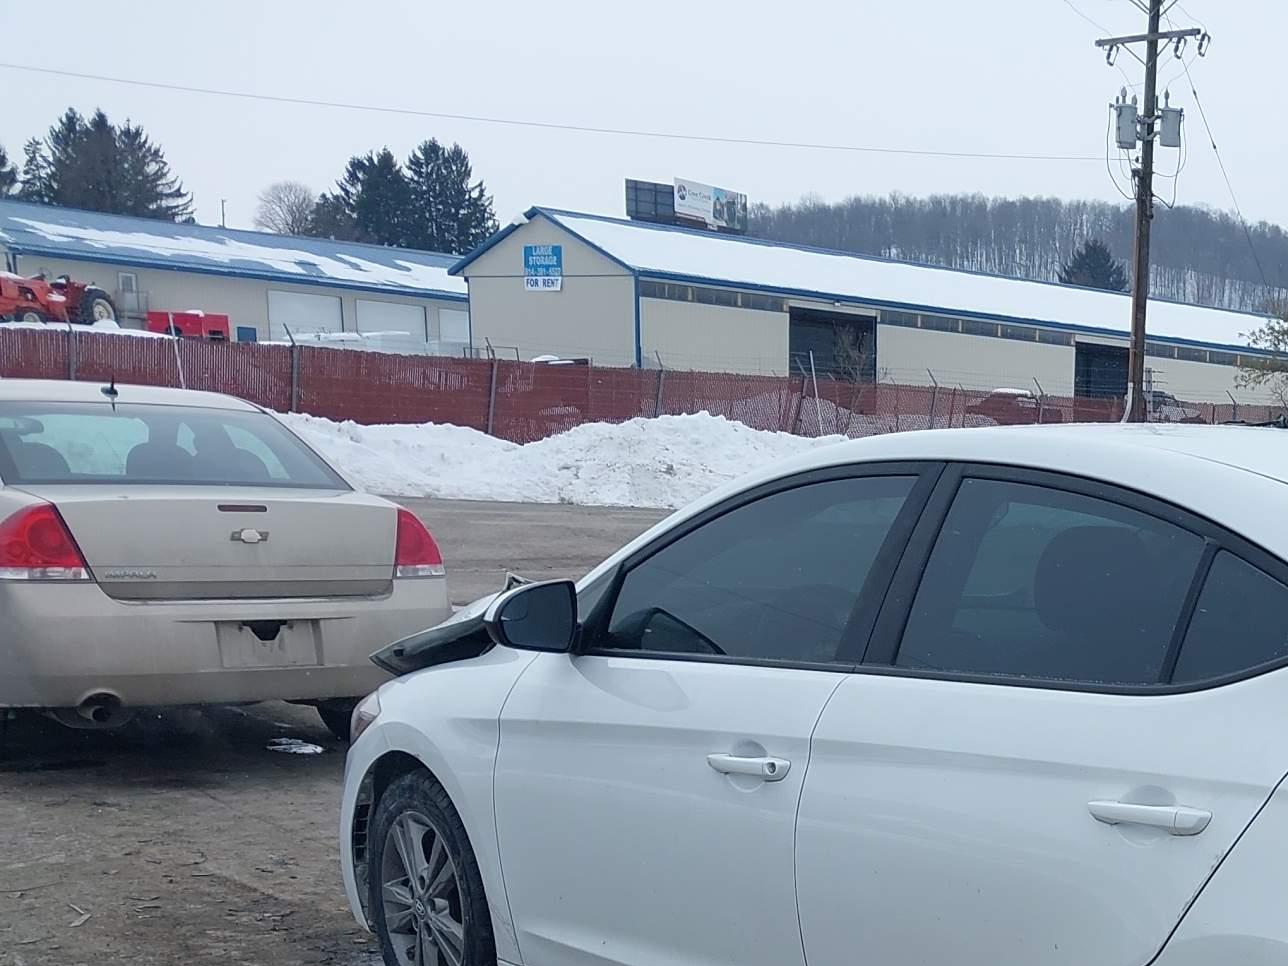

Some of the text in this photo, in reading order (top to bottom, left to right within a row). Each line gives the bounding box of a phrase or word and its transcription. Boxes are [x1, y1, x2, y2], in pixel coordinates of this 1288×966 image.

[532, 245, 553, 256] LARGE
[528, 256, 557, 265] STORAGE
[526, 278, 559, 288] FOR RENT
